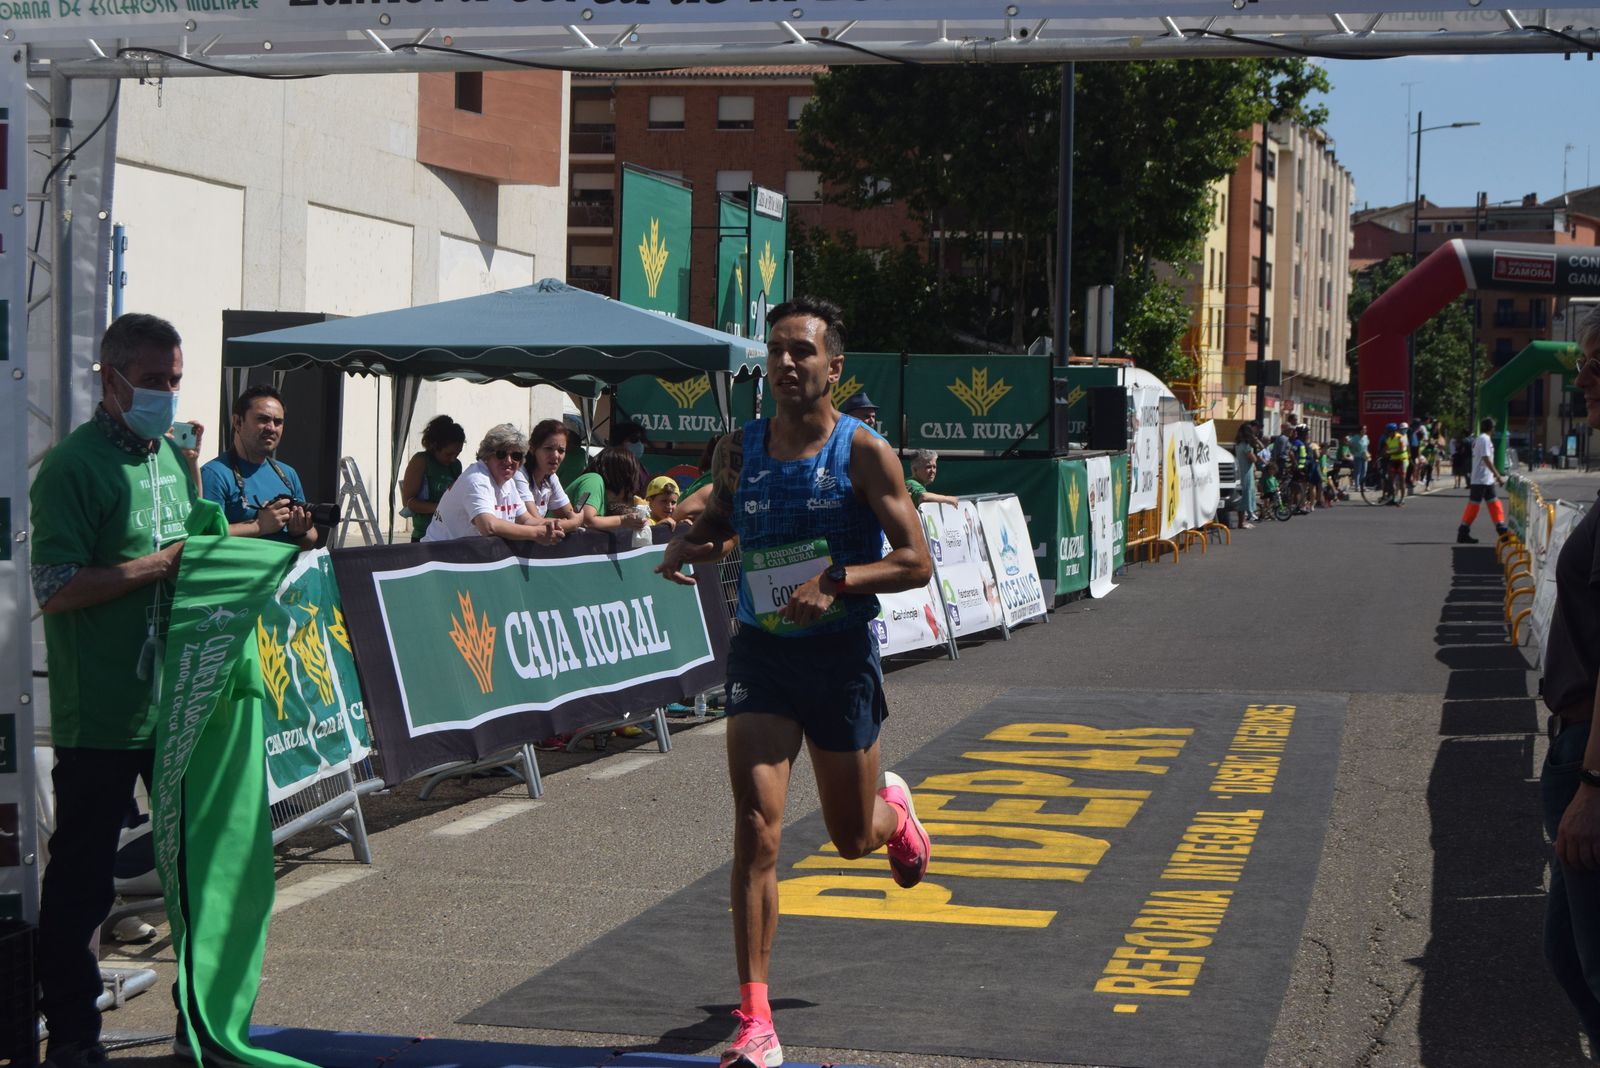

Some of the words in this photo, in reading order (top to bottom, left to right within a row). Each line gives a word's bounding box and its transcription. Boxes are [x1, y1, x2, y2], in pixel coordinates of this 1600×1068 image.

[59, 0, 81, 18] DE
[88, 0, 178, 16] ESCLEROSIS
[1508, 267, 1551, 278] ZAMORA
[631, 412, 673, 433] CAJA
[920, 422, 968, 440] CAJA
[972, 422, 1039, 440] RURAL
[767, 556, 787, 568] CAJA
[788, 550, 817, 564] RURAL
[767, 574, 774, 586] 2
[1000, 573, 1041, 610] OCEANIC
[504, 610, 582, 681] CAJA
[573, 595, 672, 668] RURAL
[168, 695, 184, 732] cerca
[1228, 704, 1297, 753] INTERIORES
[1207, 754, 1282, 793] DISEÑO
[1160, 809, 1265, 882] INTEGRAL
[1093, 889, 1234, 997] REFORMA
